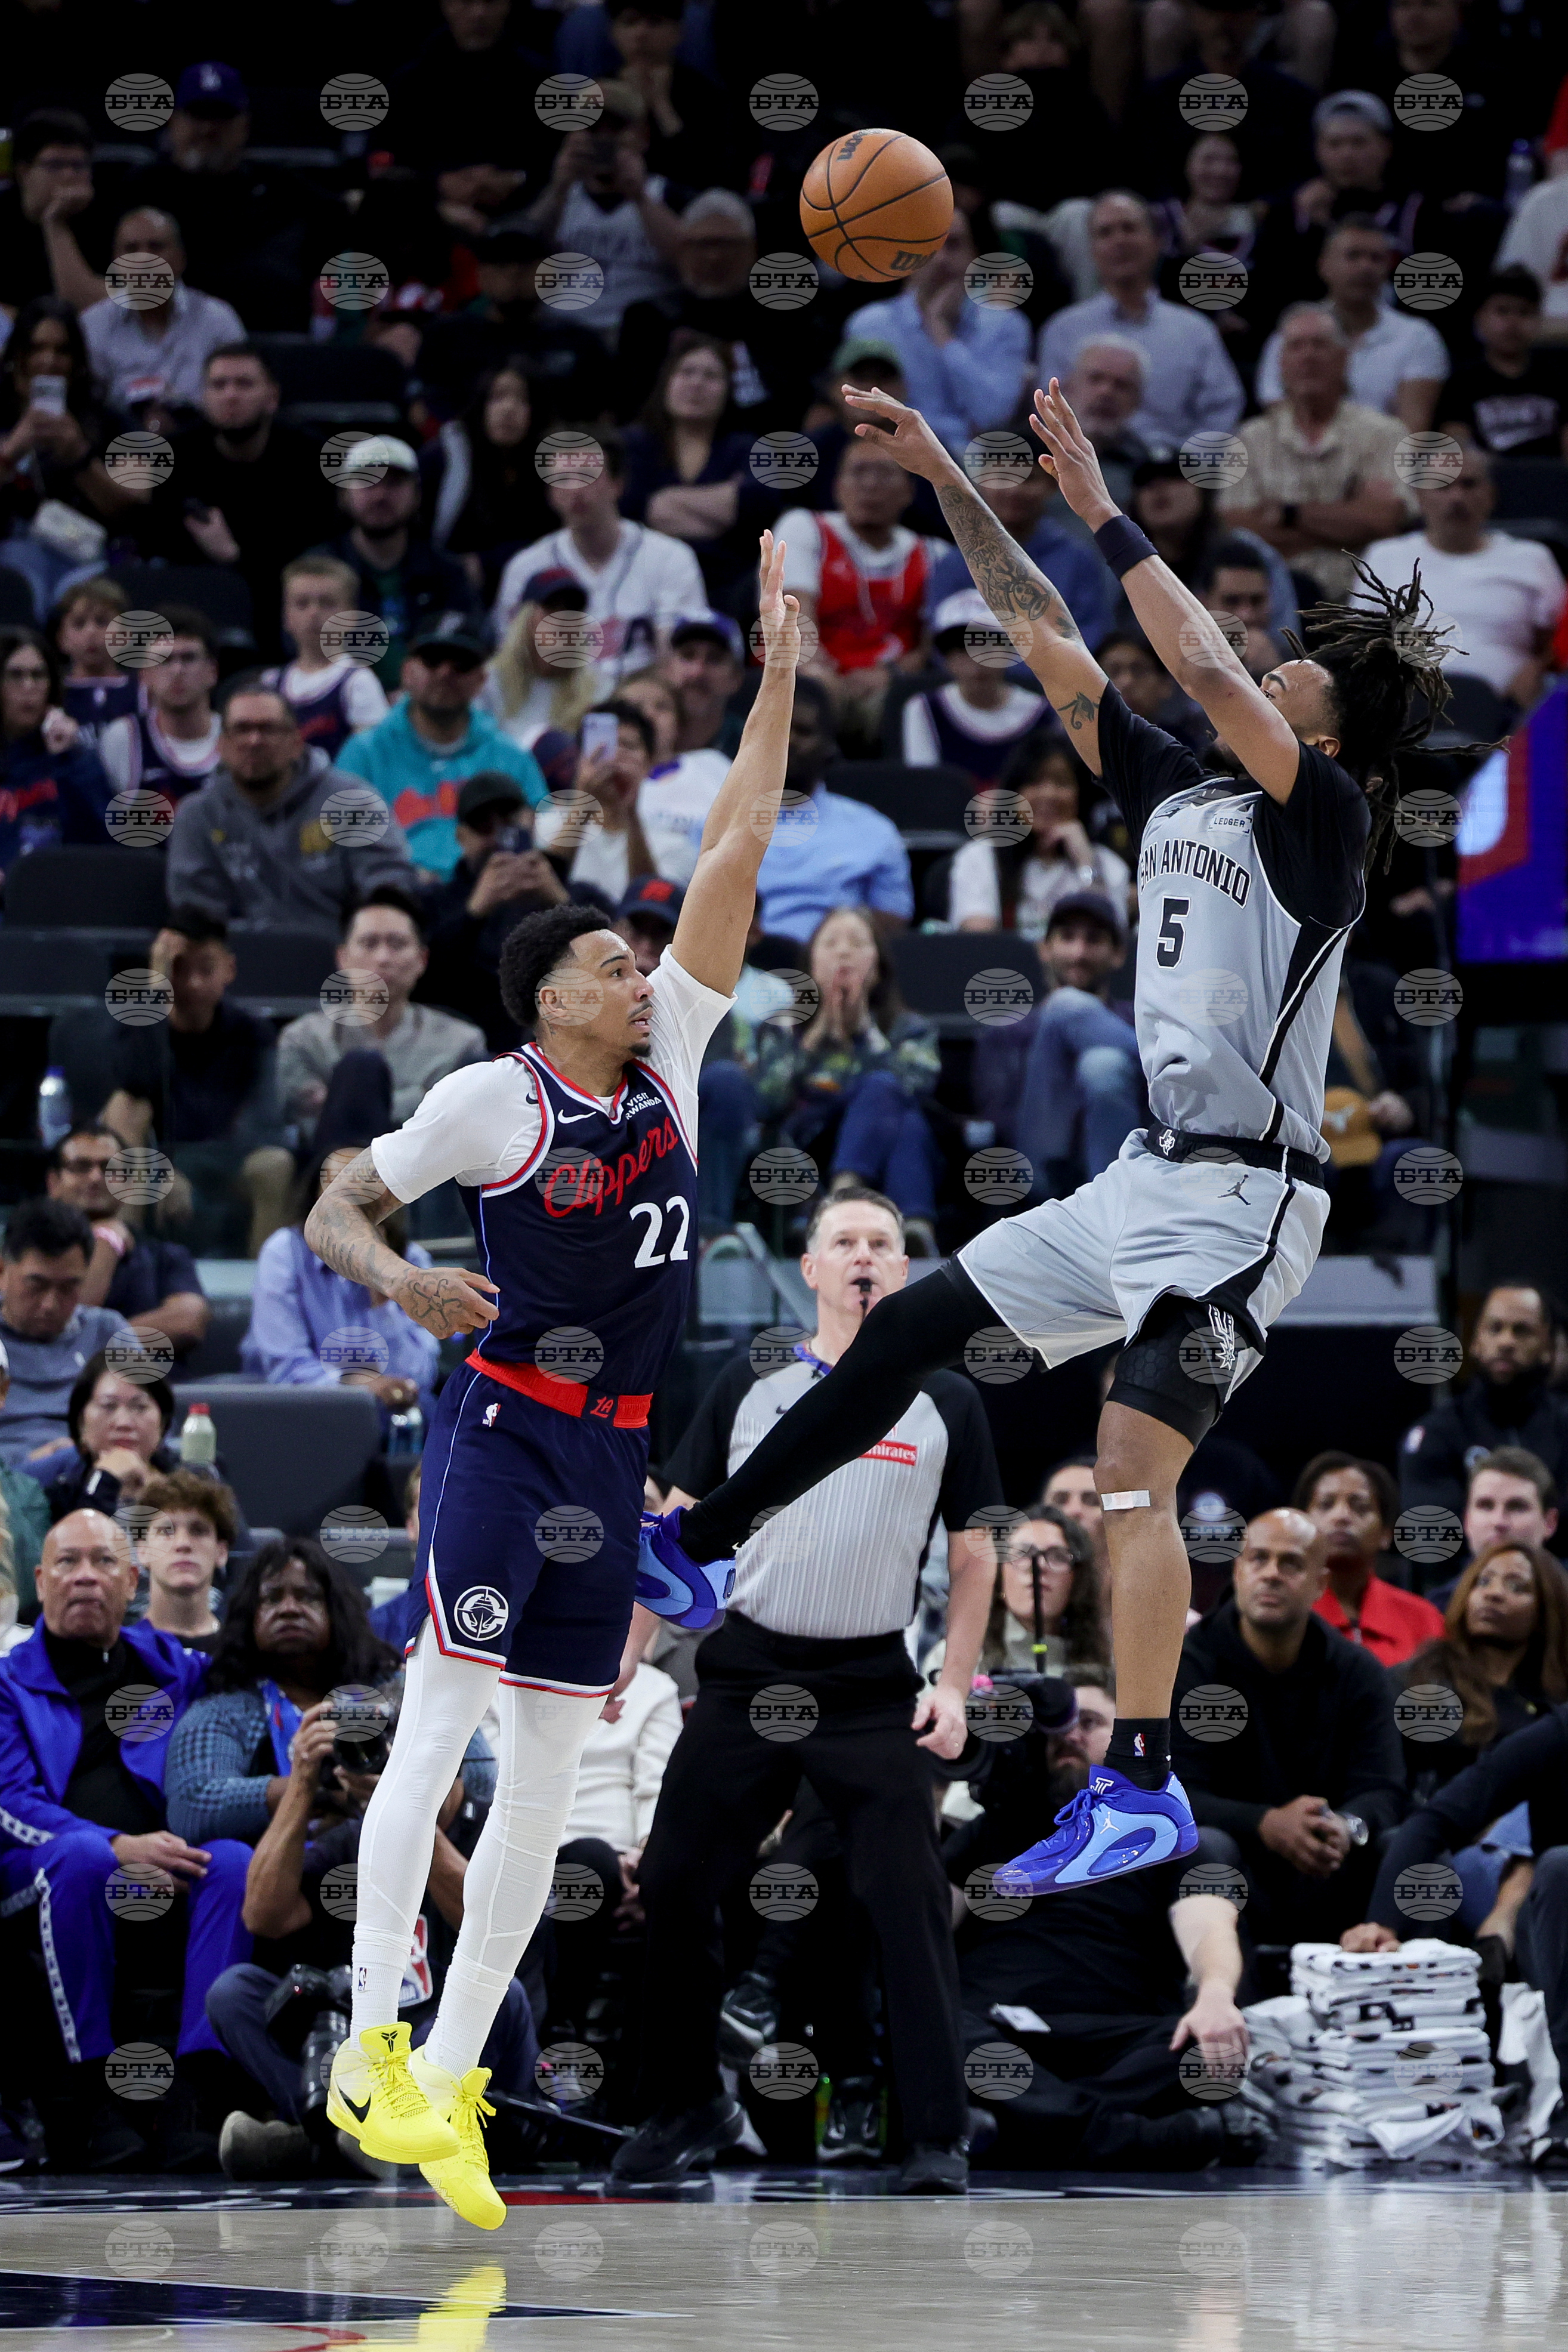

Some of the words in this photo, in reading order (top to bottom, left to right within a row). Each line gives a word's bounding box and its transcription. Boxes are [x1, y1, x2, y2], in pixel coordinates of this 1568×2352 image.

[1214, 817, 1246, 828] LEDGER
[1159, 838, 1252, 909] ANTONIO
[1156, 895, 1191, 970] 5
[625, 1097, 663, 1121] RWANDA
[626, 1092, 649, 1107] VISIT
[544, 1116, 678, 1218] Clippers
[629, 1195, 690, 1268] 22
[865, 1442, 916, 1462] mirates
